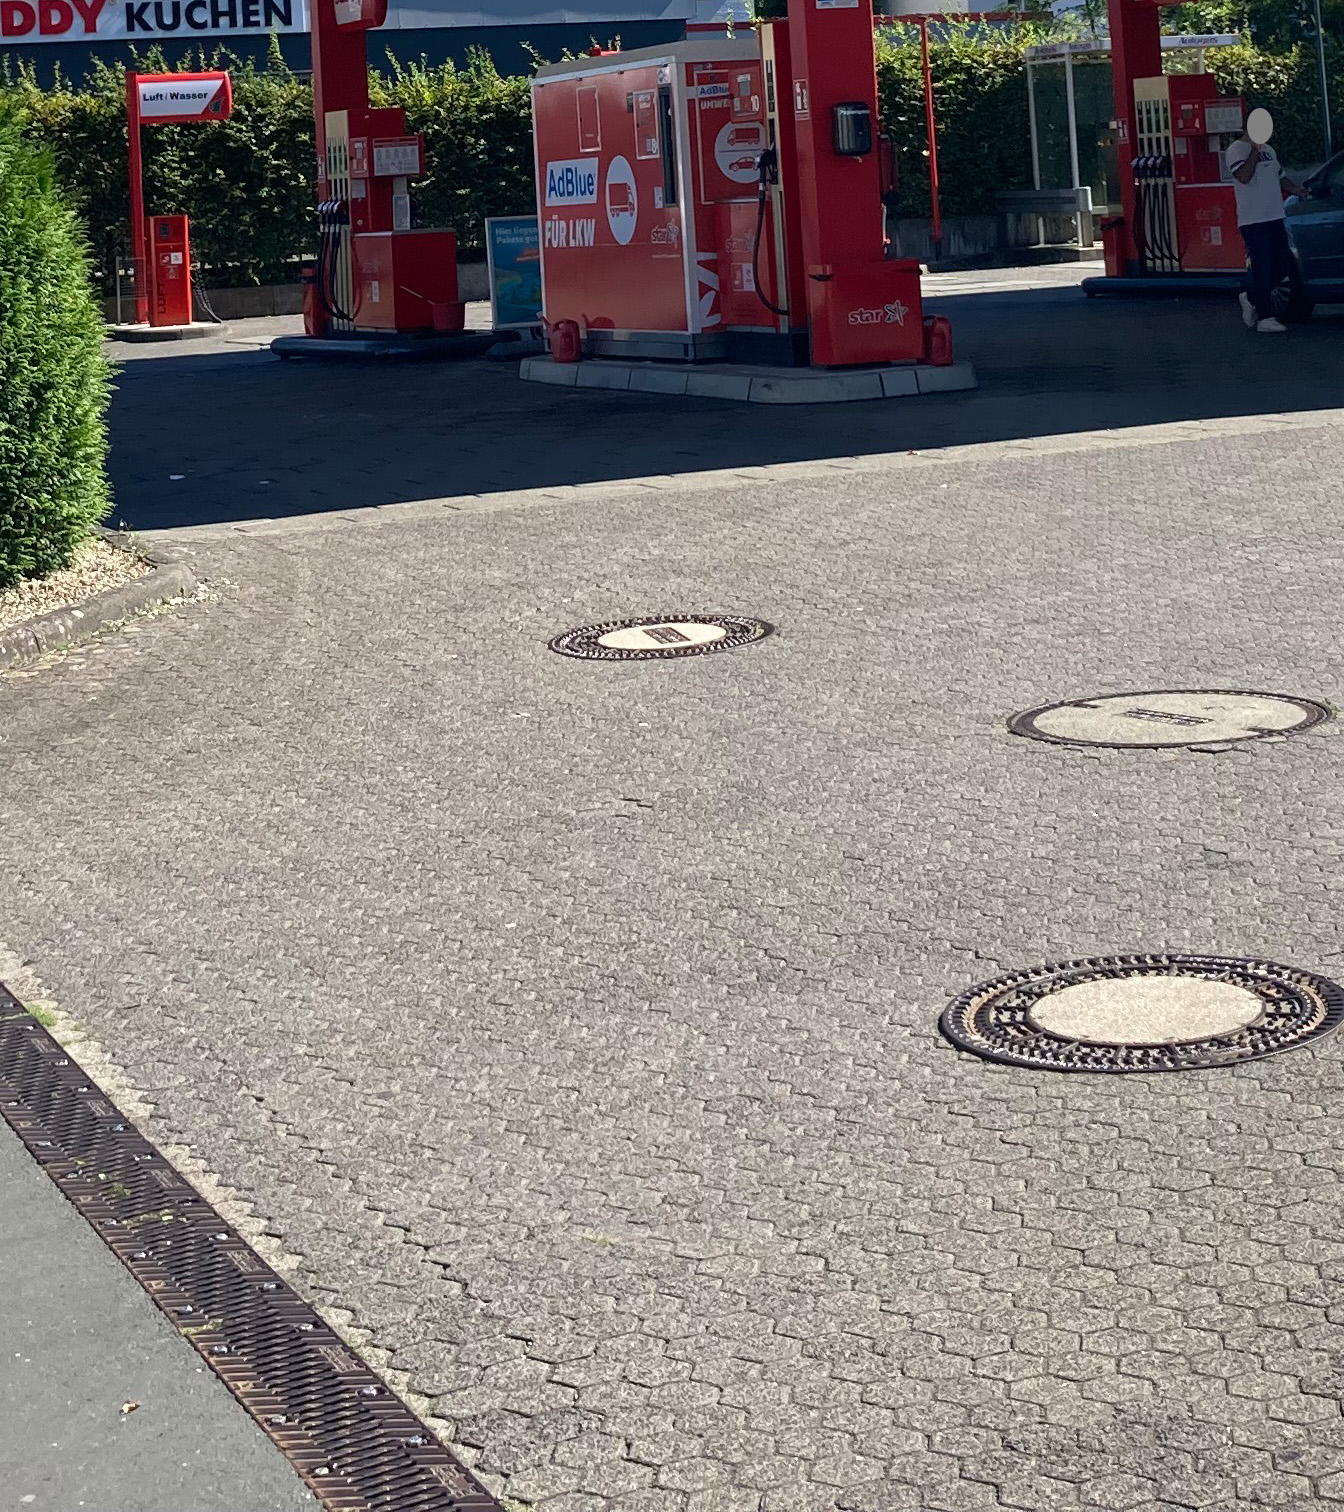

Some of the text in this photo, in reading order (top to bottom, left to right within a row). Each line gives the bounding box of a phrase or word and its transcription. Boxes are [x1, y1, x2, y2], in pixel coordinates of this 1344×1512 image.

[547, 166, 595, 199] AdBlue
[544, 214, 596, 248] FÜR LKW
[848, 307, 883, 325] star
